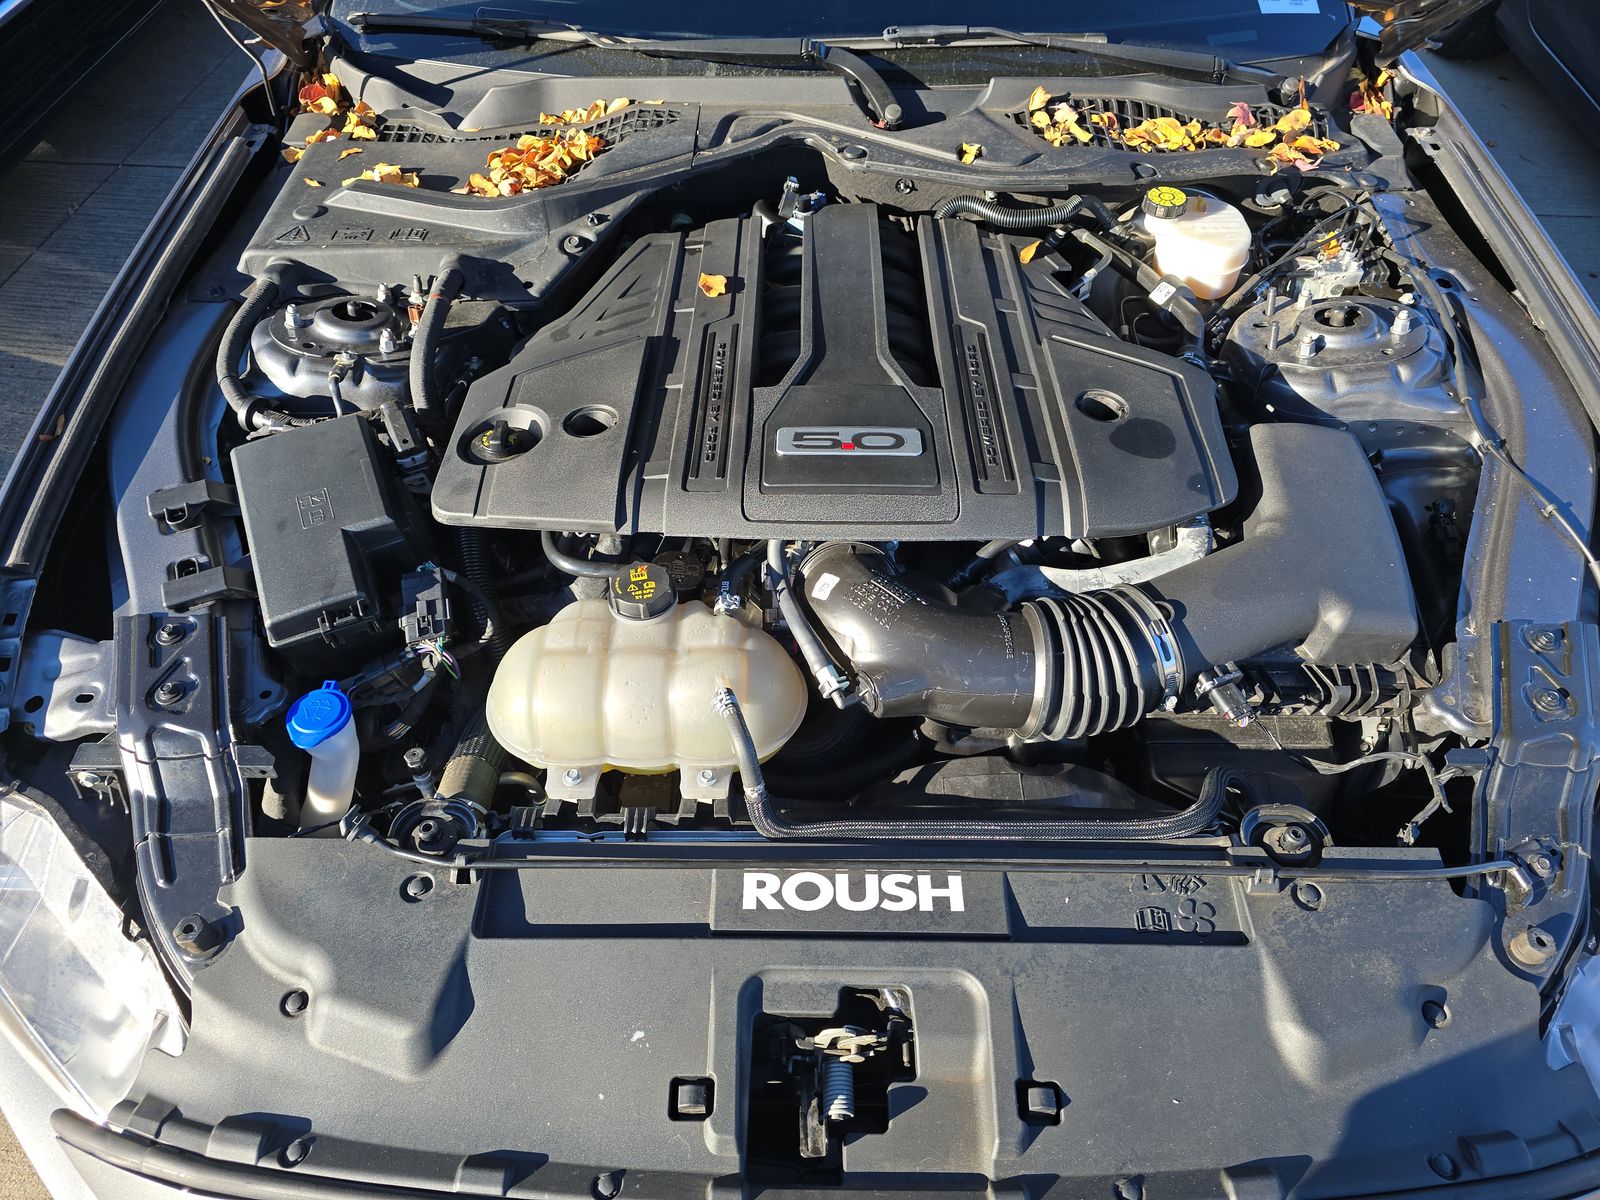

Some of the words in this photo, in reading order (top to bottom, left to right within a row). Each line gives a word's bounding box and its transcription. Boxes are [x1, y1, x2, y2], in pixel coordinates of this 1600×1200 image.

[711, 342, 727, 401] POWERED
[966, 344, 981, 377] FORD
[972, 380, 985, 398] BY
[708, 404, 721, 422] BY
[704, 426, 719, 462] FORD
[792, 431, 906, 450] 5.0
[975, 402, 999, 466] POWERED
[842, 591, 867, 610] MADE
[864, 605, 876, 617] IN
[874, 612, 893, 632] USA
[742, 871, 965, 912] ROUSH
